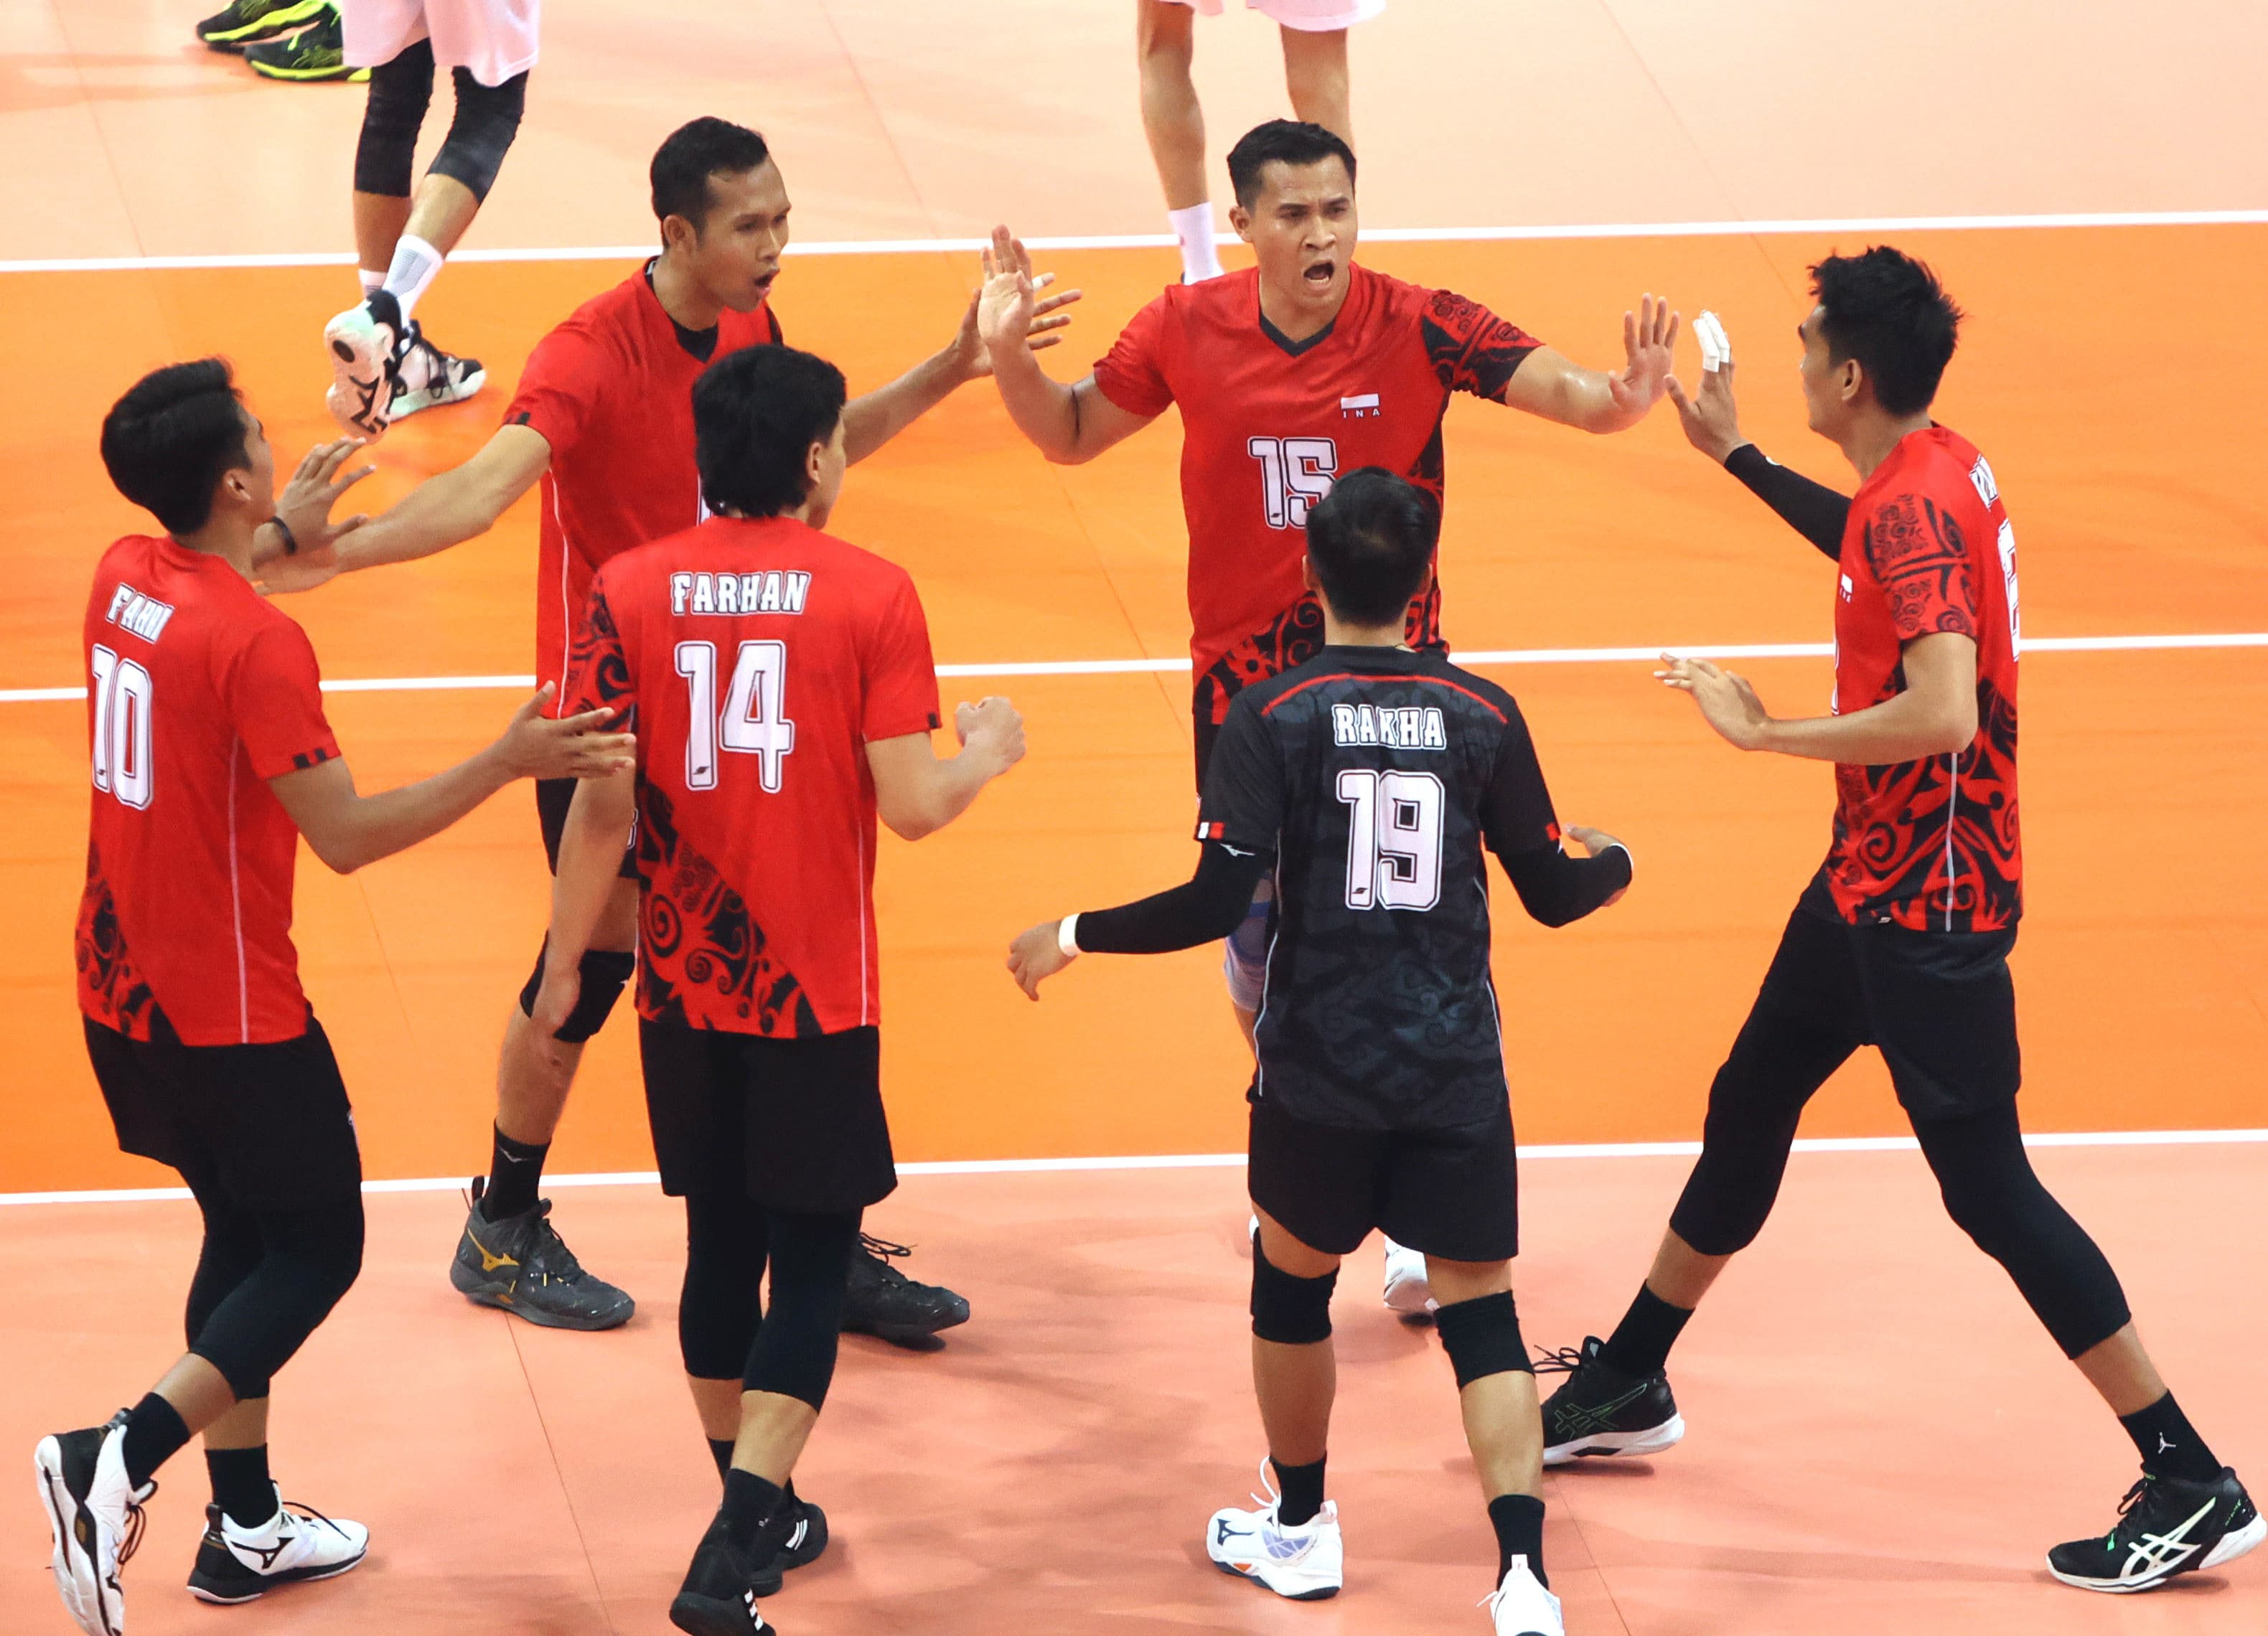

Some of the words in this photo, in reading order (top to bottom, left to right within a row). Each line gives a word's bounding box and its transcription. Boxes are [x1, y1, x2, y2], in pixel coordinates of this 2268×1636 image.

[1343, 408, 1380, 418] INA
[1247, 436, 1338, 530] 15
[670, 570, 811, 615] FARHAN
[92, 643, 154, 811] 10
[674, 639, 795, 794] 14
[1331, 703, 1447, 751] RAKHA
[1336, 768, 1445, 912] 19
